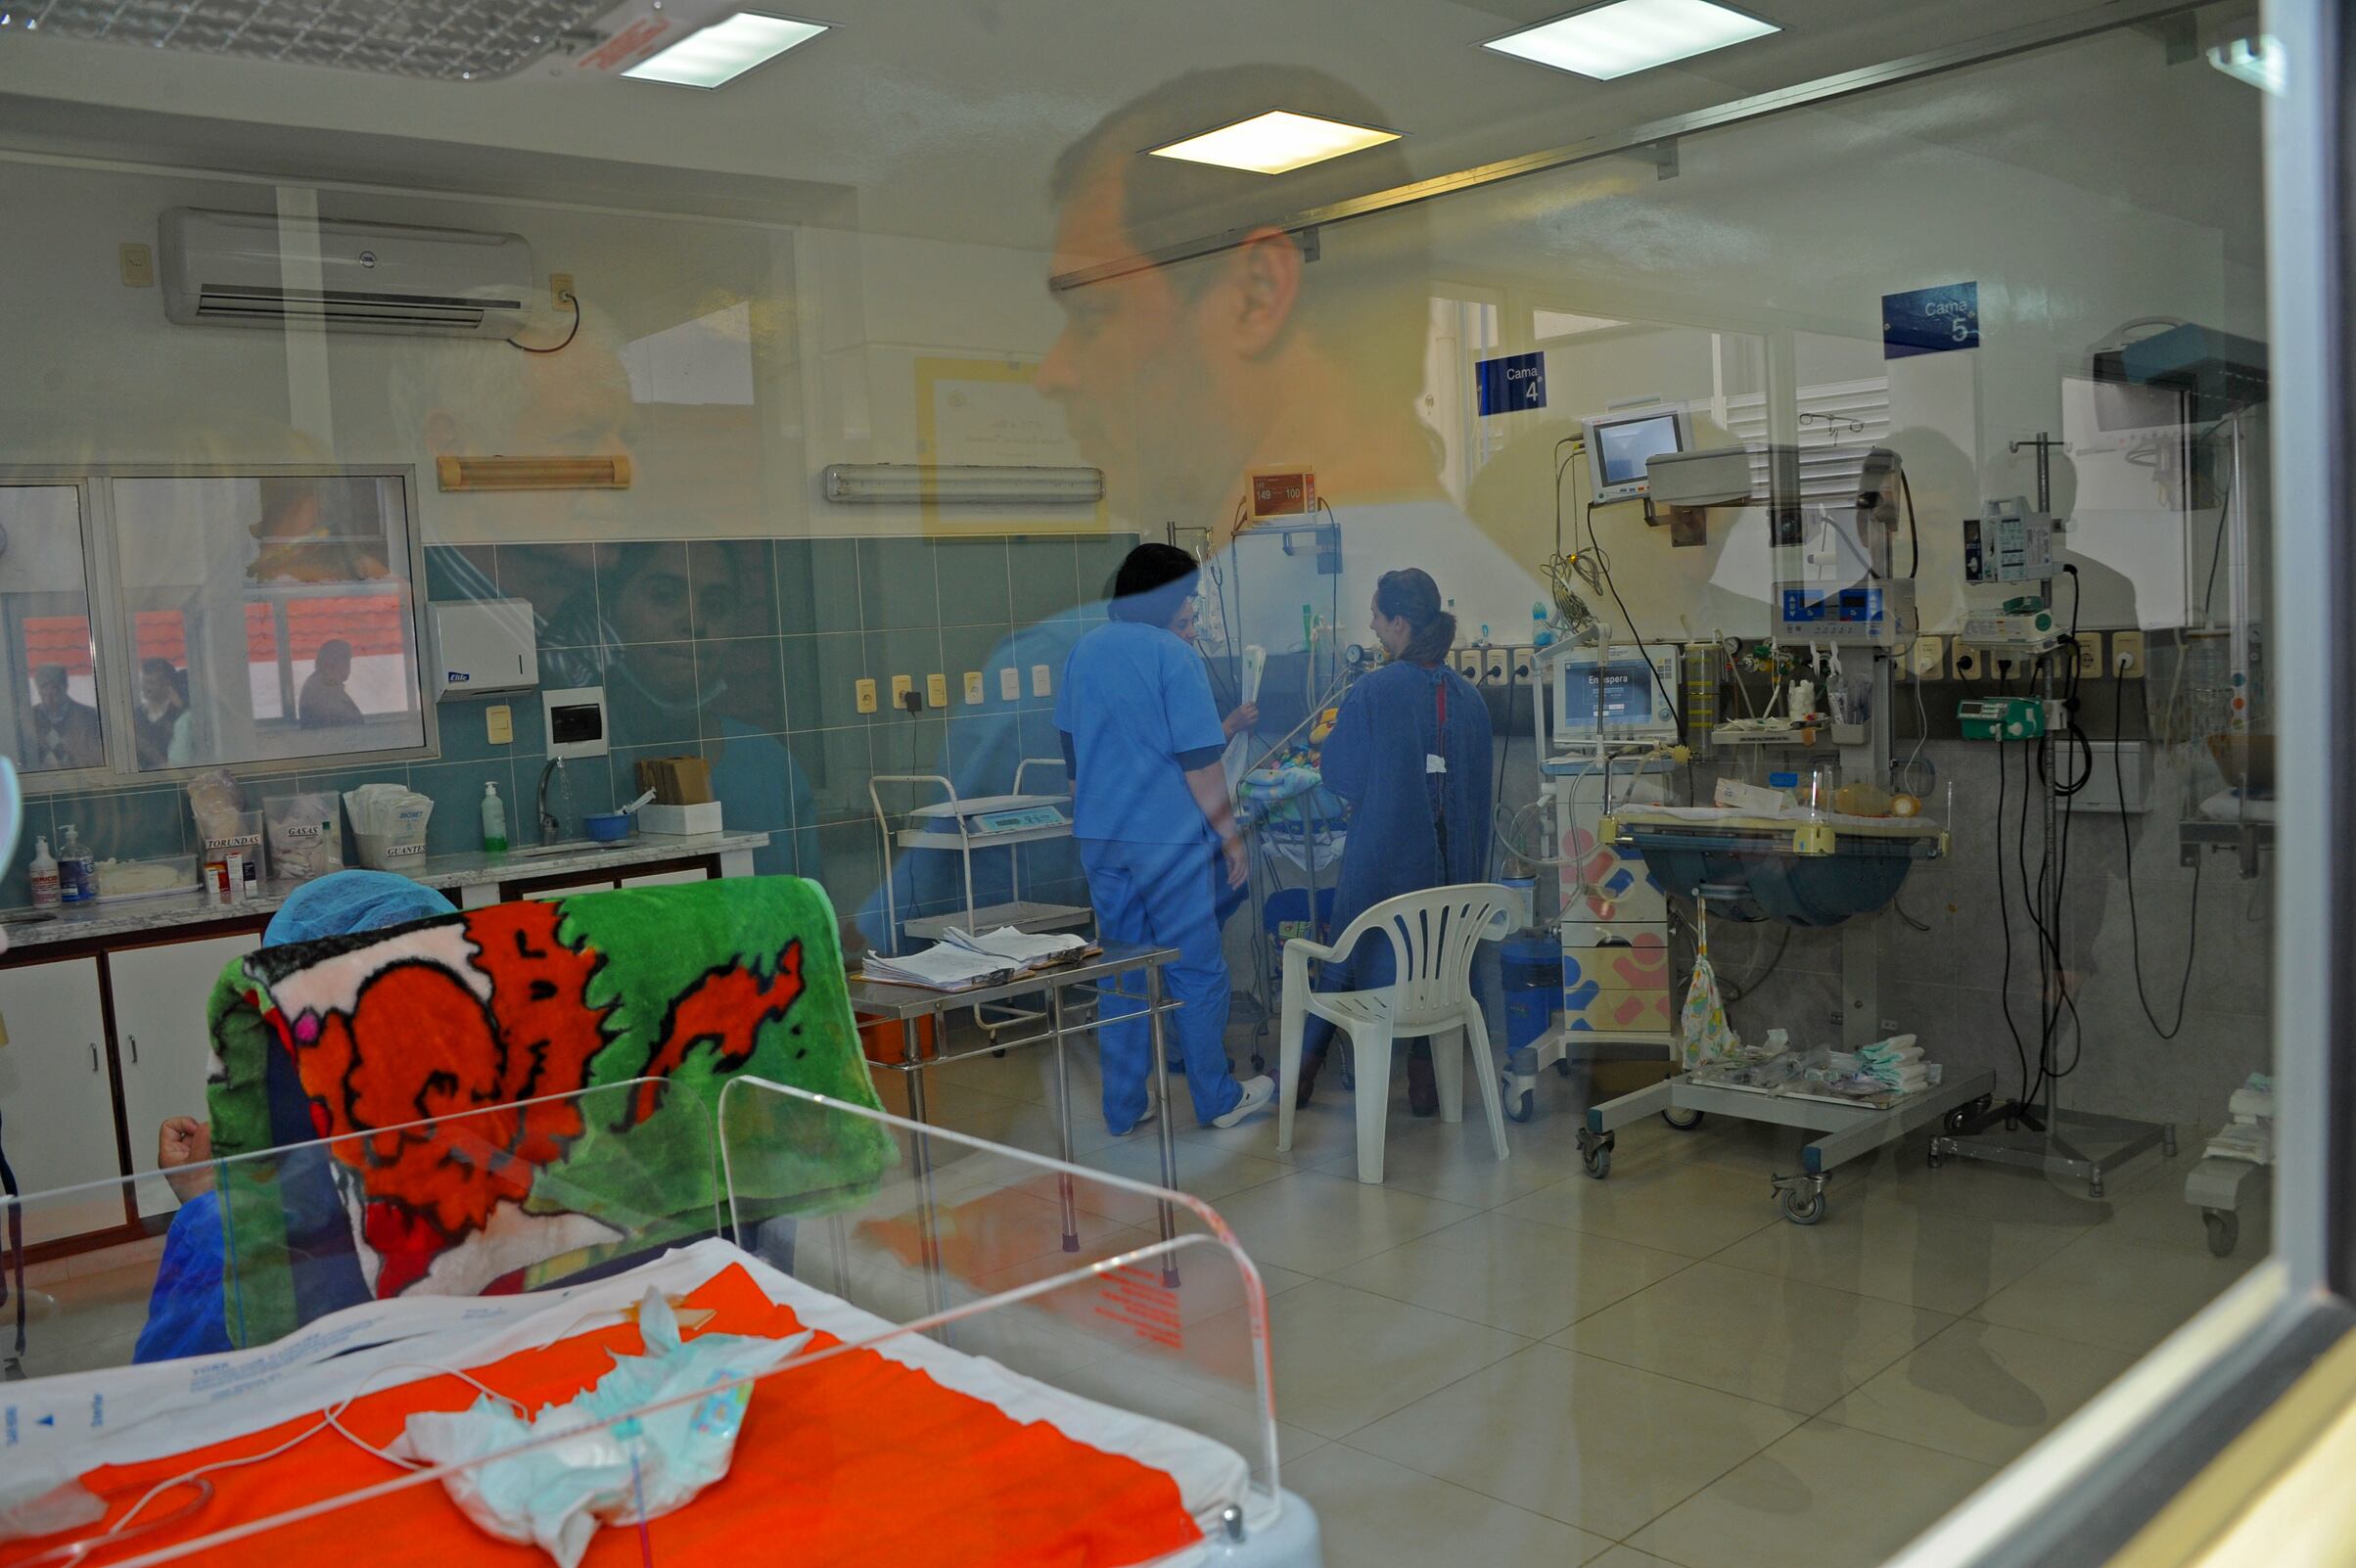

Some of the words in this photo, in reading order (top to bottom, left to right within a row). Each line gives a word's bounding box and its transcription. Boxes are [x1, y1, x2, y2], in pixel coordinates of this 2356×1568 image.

[1925, 300, 1966, 316] Cama
[1952, 317, 1968, 342] 5
[1506, 367, 1538, 380] Cama
[1526, 382, 1539, 401] 4
[1257, 489, 1271, 500] 149
[1286, 488, 1301, 499] 100
[1601, 674, 1629, 685] spera
[288, 826, 319, 836] GASAS
[208, 835, 259, 848] TORUNDAS
